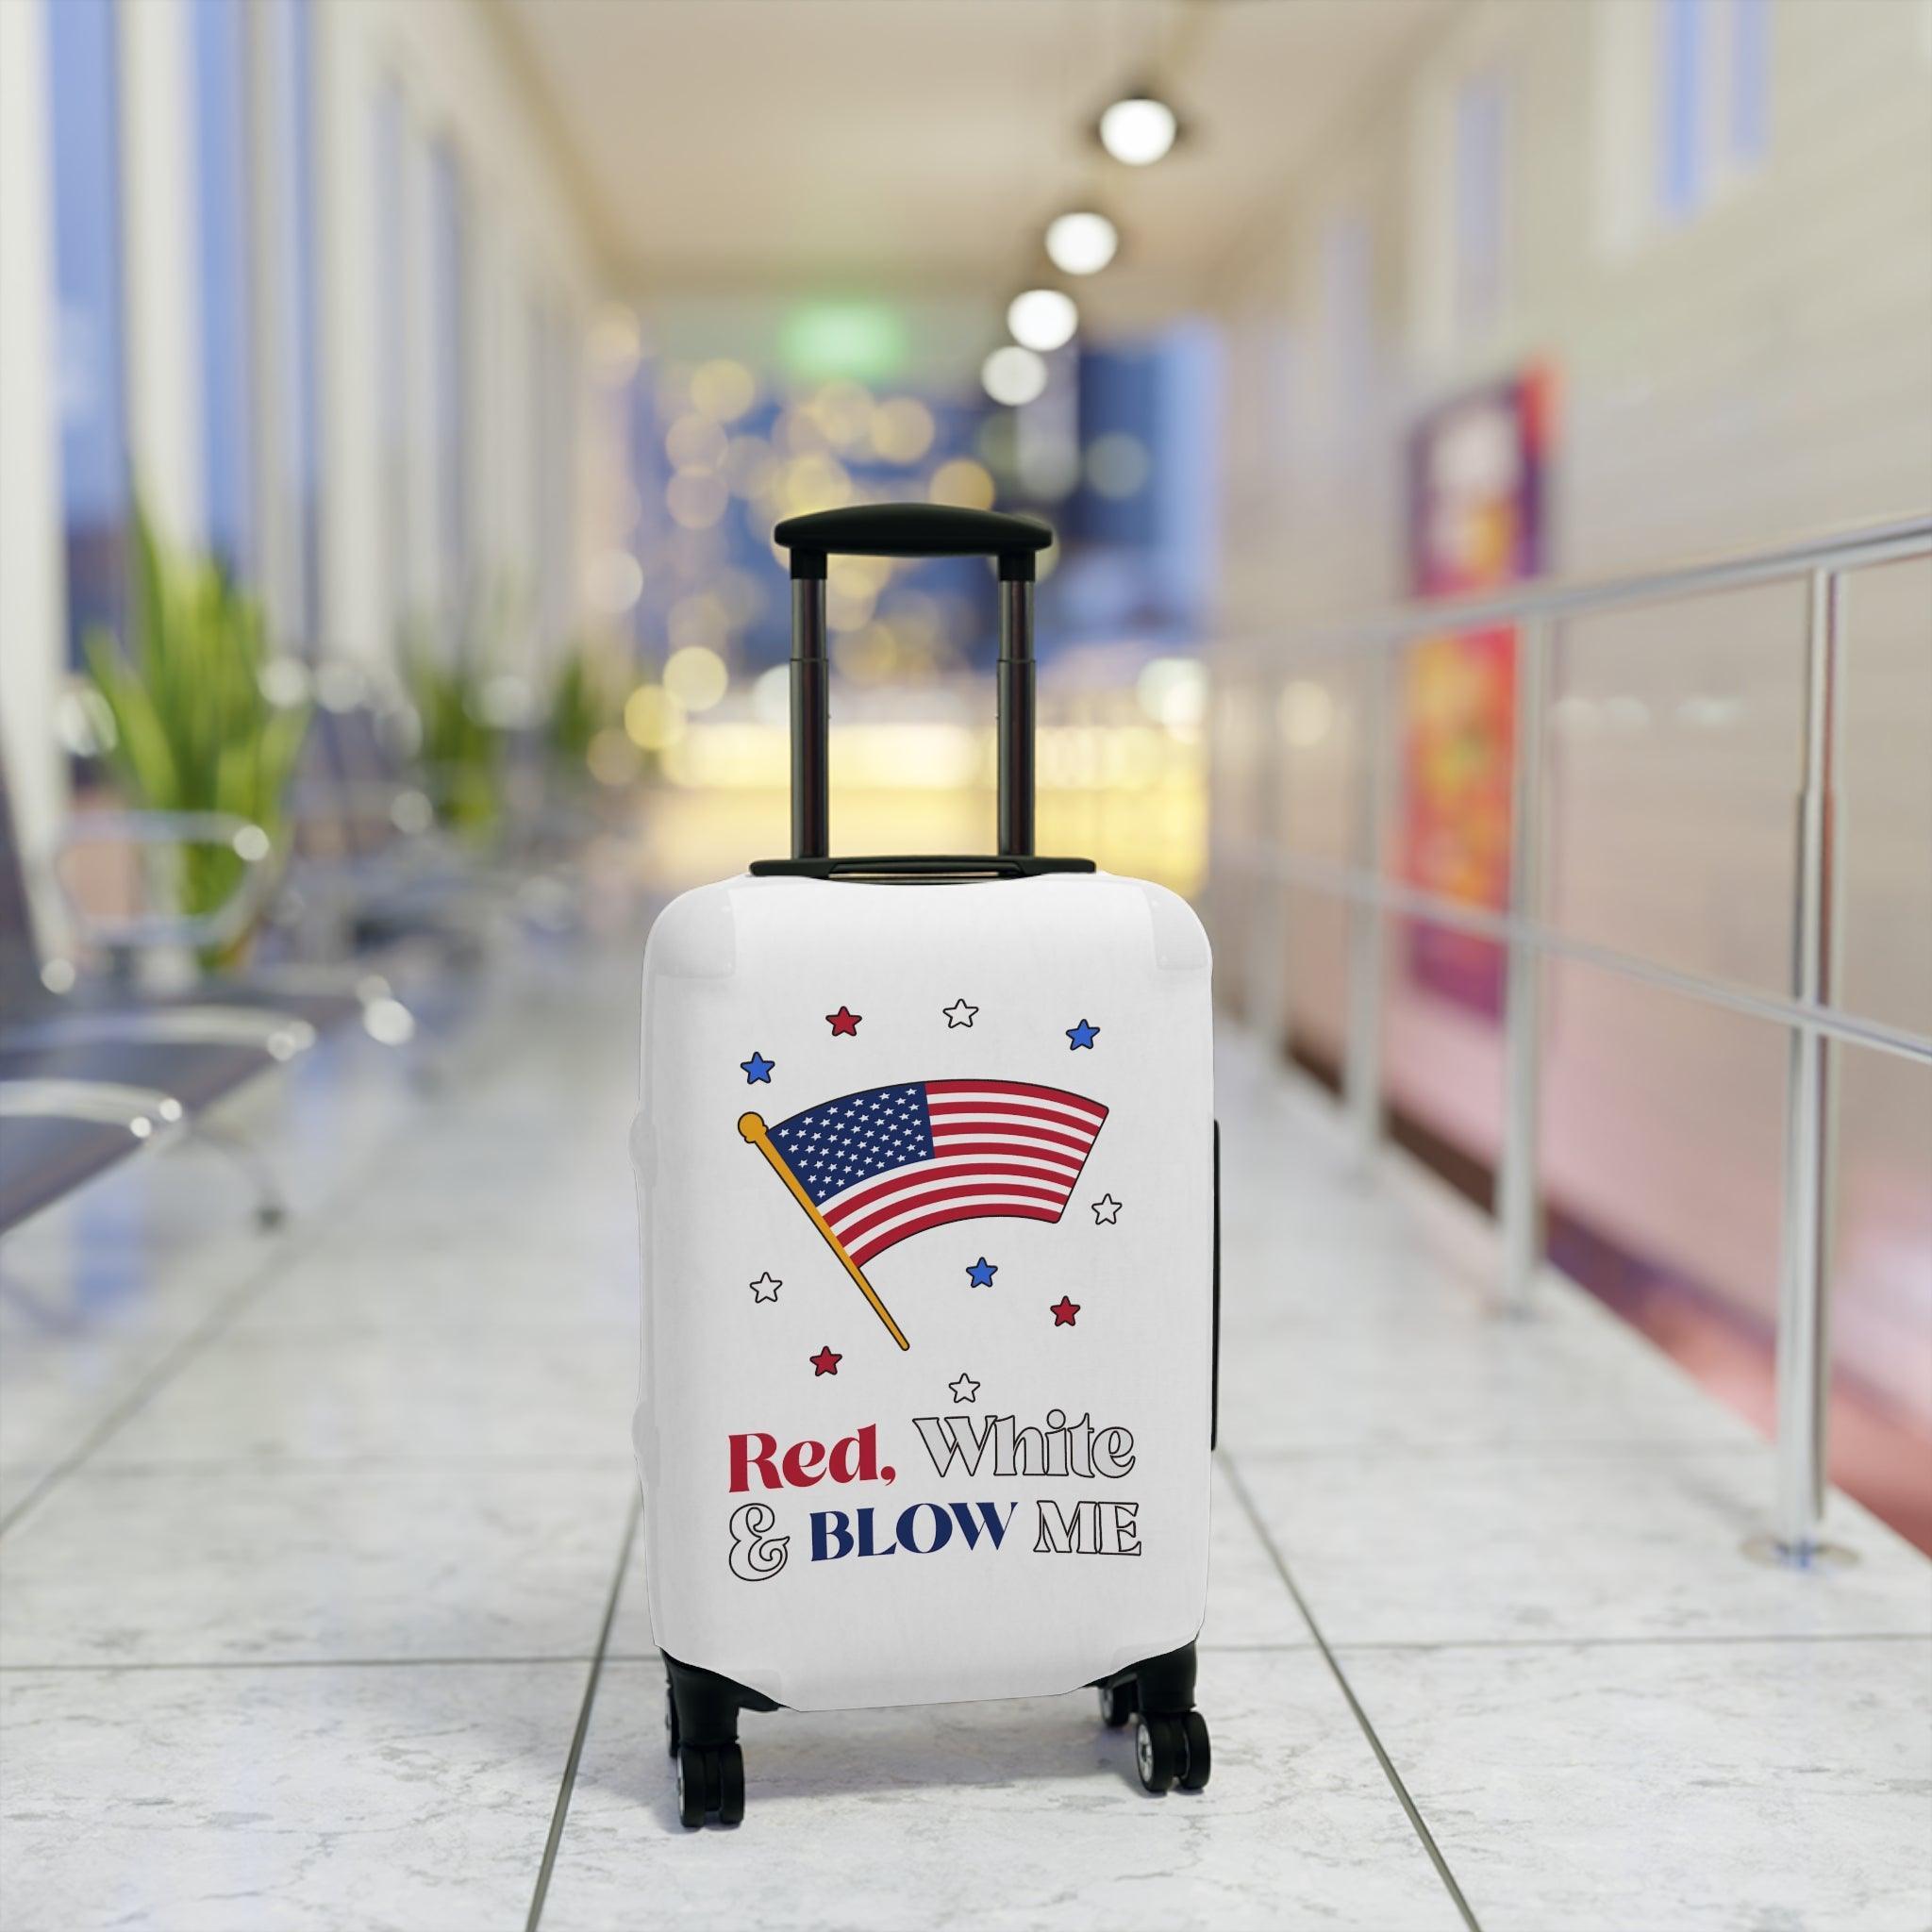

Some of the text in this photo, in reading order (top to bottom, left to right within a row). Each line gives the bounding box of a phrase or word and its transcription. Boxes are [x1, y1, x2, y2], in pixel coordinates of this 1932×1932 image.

[727, 1408, 1137, 1493] Red, White
[728, 1499, 1142, 1582] & BLOW ME
